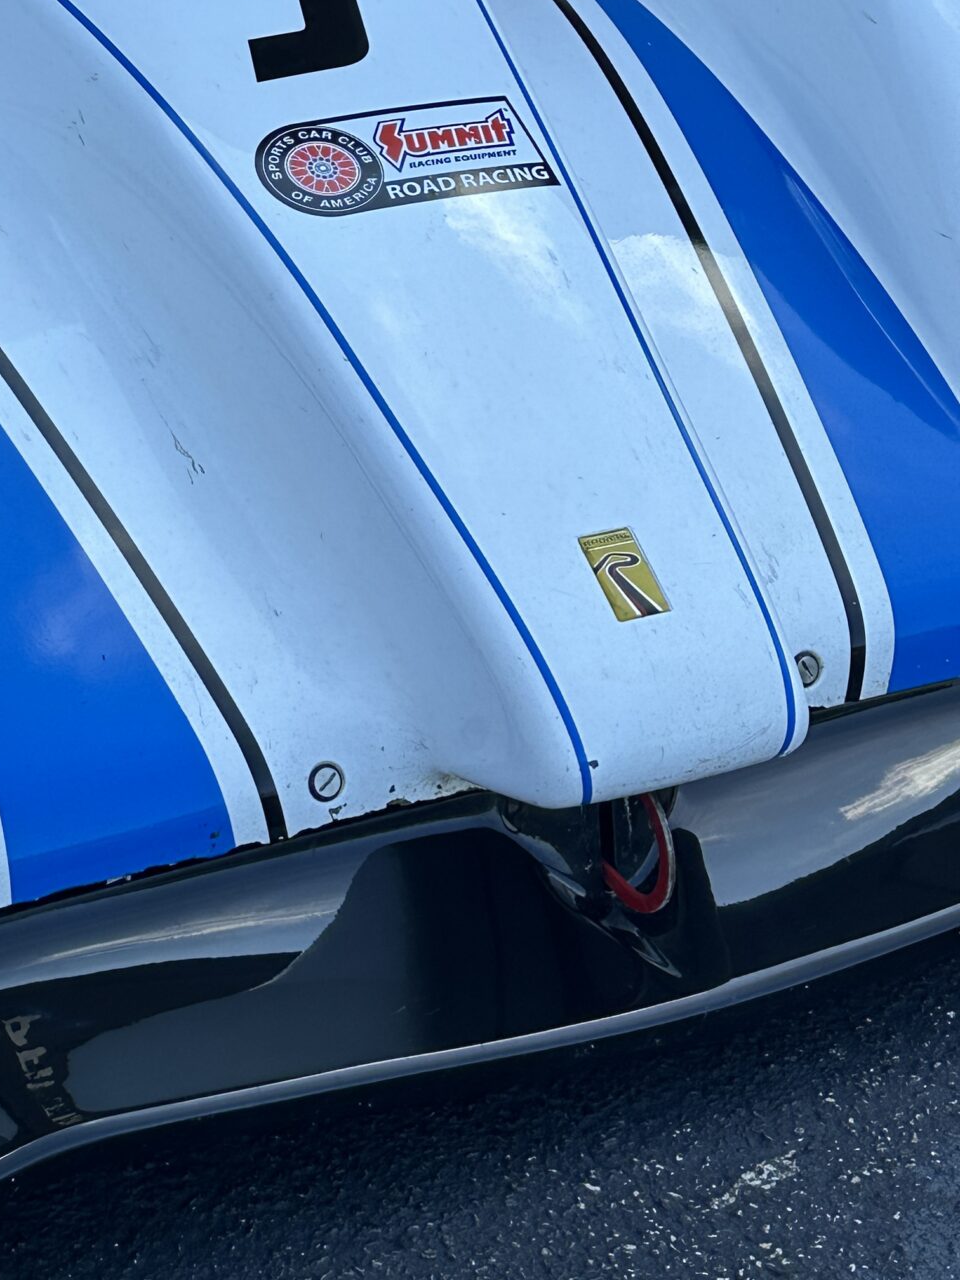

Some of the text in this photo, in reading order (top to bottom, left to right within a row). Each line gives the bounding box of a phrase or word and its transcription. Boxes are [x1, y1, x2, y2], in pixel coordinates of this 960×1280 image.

[267, 129, 373, 181] SPORTS CAR CLUB
[408, 148, 518, 169] RACING EQUIPMENT
[291, 174, 378, 209] OF AMERICA
[386, 164, 550, 200] ROAD RACING
